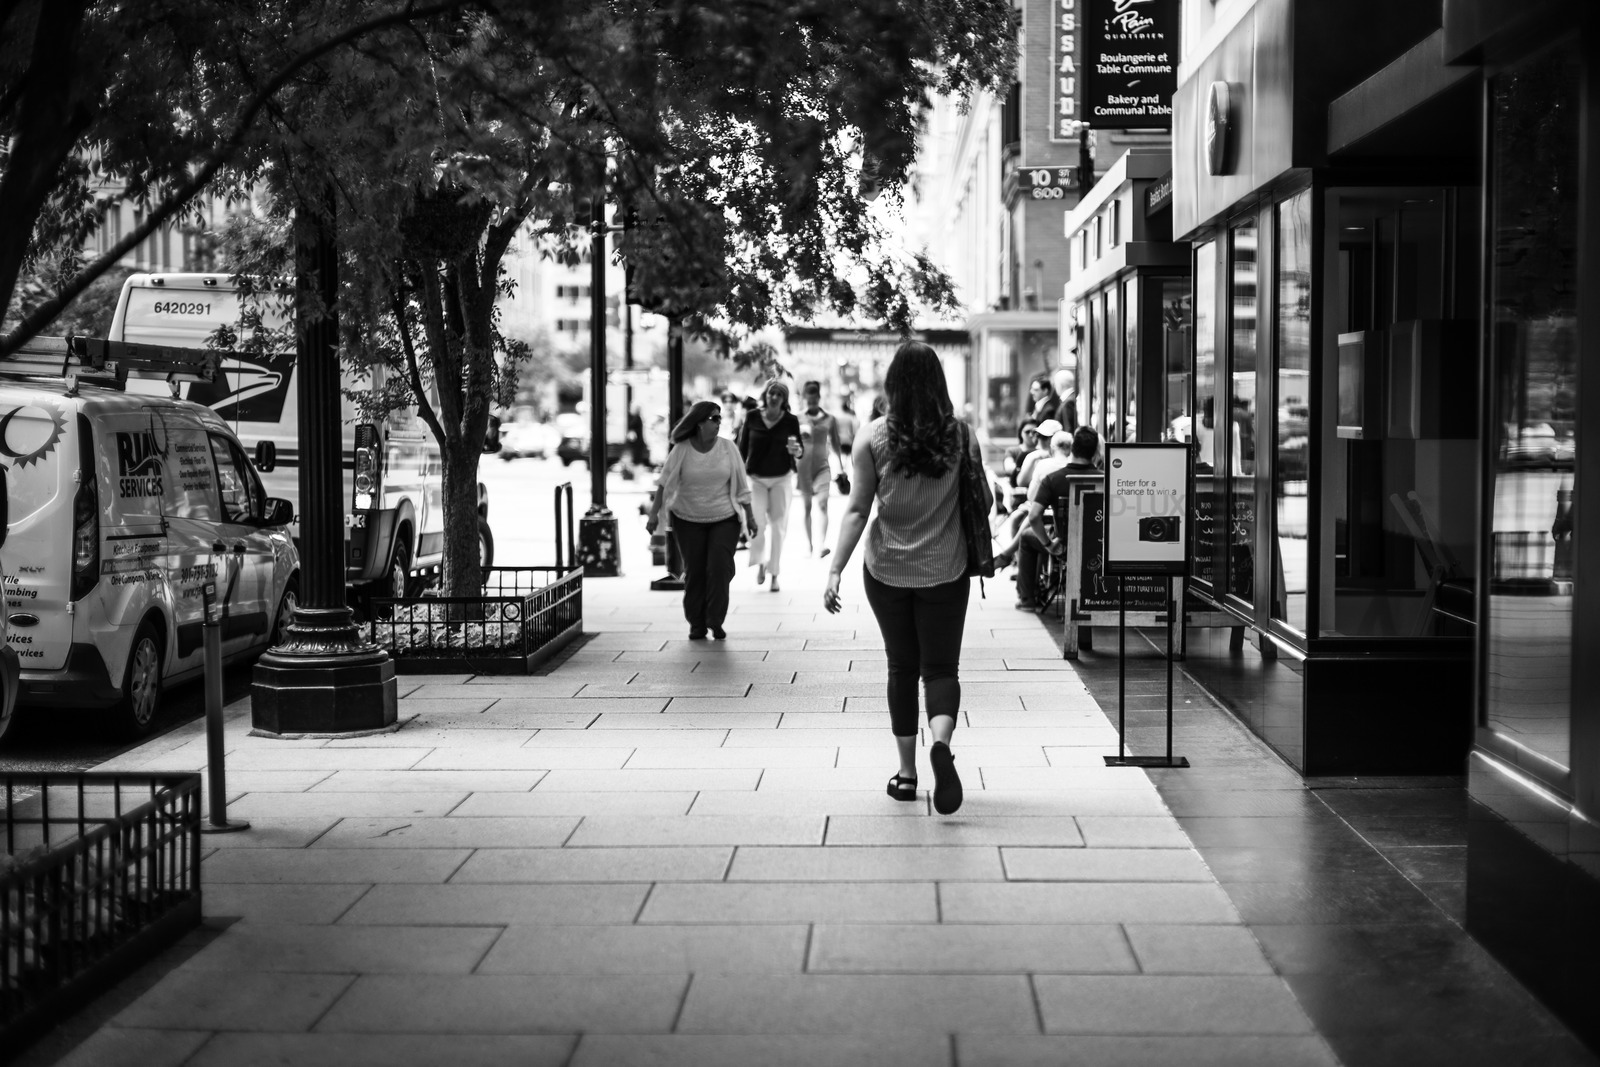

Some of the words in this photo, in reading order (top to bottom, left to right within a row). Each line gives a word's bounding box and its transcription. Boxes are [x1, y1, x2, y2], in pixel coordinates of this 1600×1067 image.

[1112, 11, 1154, 32] Pain
[1100, 52, 1156, 65] Boulangerie
[1157, 52, 1169, 62] et
[1096, 64, 1121, 74] Table
[1122, 64, 1172, 74] Commune
[1107, 94, 1139, 106] Bakery
[1140, 94, 1160, 104] and
[1094, 105, 1146, 115] Communal
[1147, 105, 1173, 115] Table
[1029, 169, 1051, 186] 10
[1058, 177, 1071, 186] NW
[1032, 187, 1064, 199] 600
[154, 302, 211, 315] 6420291
[119, 478, 164, 498] SERVICES
[1116, 479, 1137, 487] Enter
[1139, 479, 1149, 487] for
[1116, 488, 1144, 496] chance
[1146, 488, 1154, 496] to
[1156, 487, 1170, 495] win
[1110, 494, 1185, 517] D-LUX
[5, 588, 38, 599] mbing
[6, 634, 33, 643] vices
